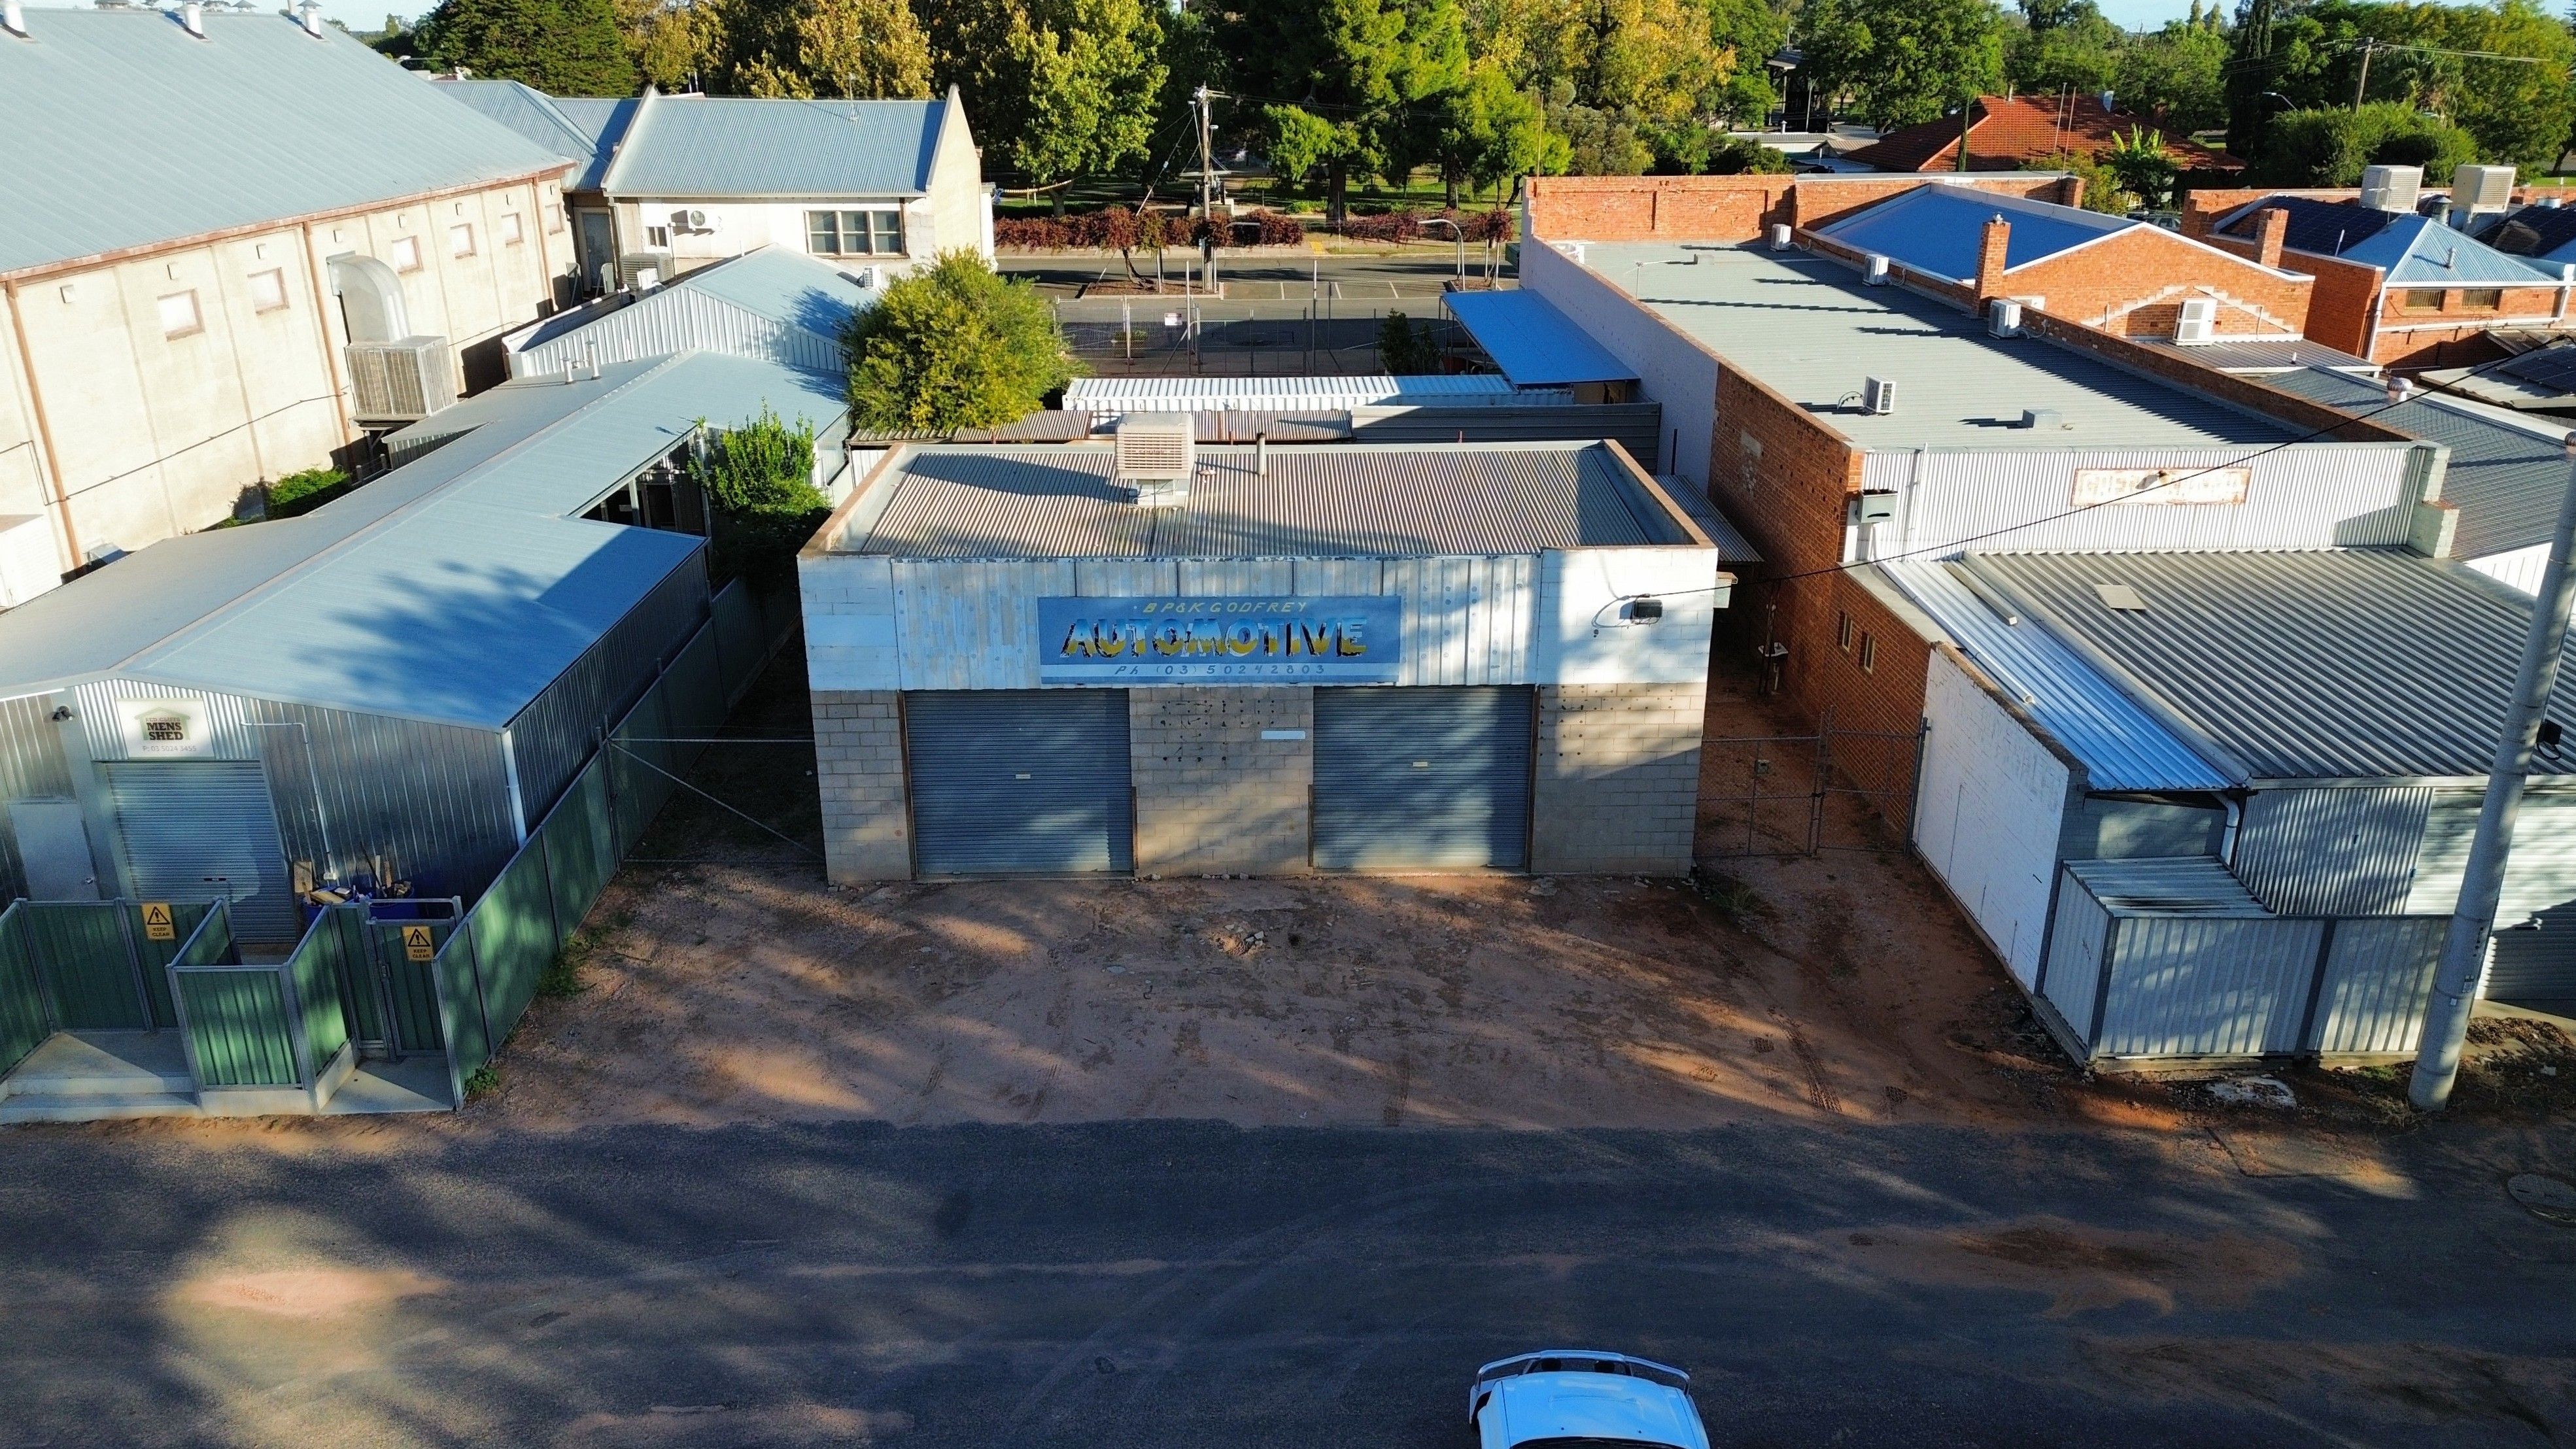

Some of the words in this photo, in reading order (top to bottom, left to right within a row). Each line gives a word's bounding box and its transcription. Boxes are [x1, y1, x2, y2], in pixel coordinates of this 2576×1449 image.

[1209, 602, 1307, 613] GODFREY
[1060, 617, 1367, 658] AUTOMOTIVE
[1114, 666, 1139, 675] Ph
[1156, 665, 1197, 674] (03)
[1206, 664, 1324, 674] 50242803
[146, 722, 182, 730] MENS
[148, 731, 184, 740] SHED
